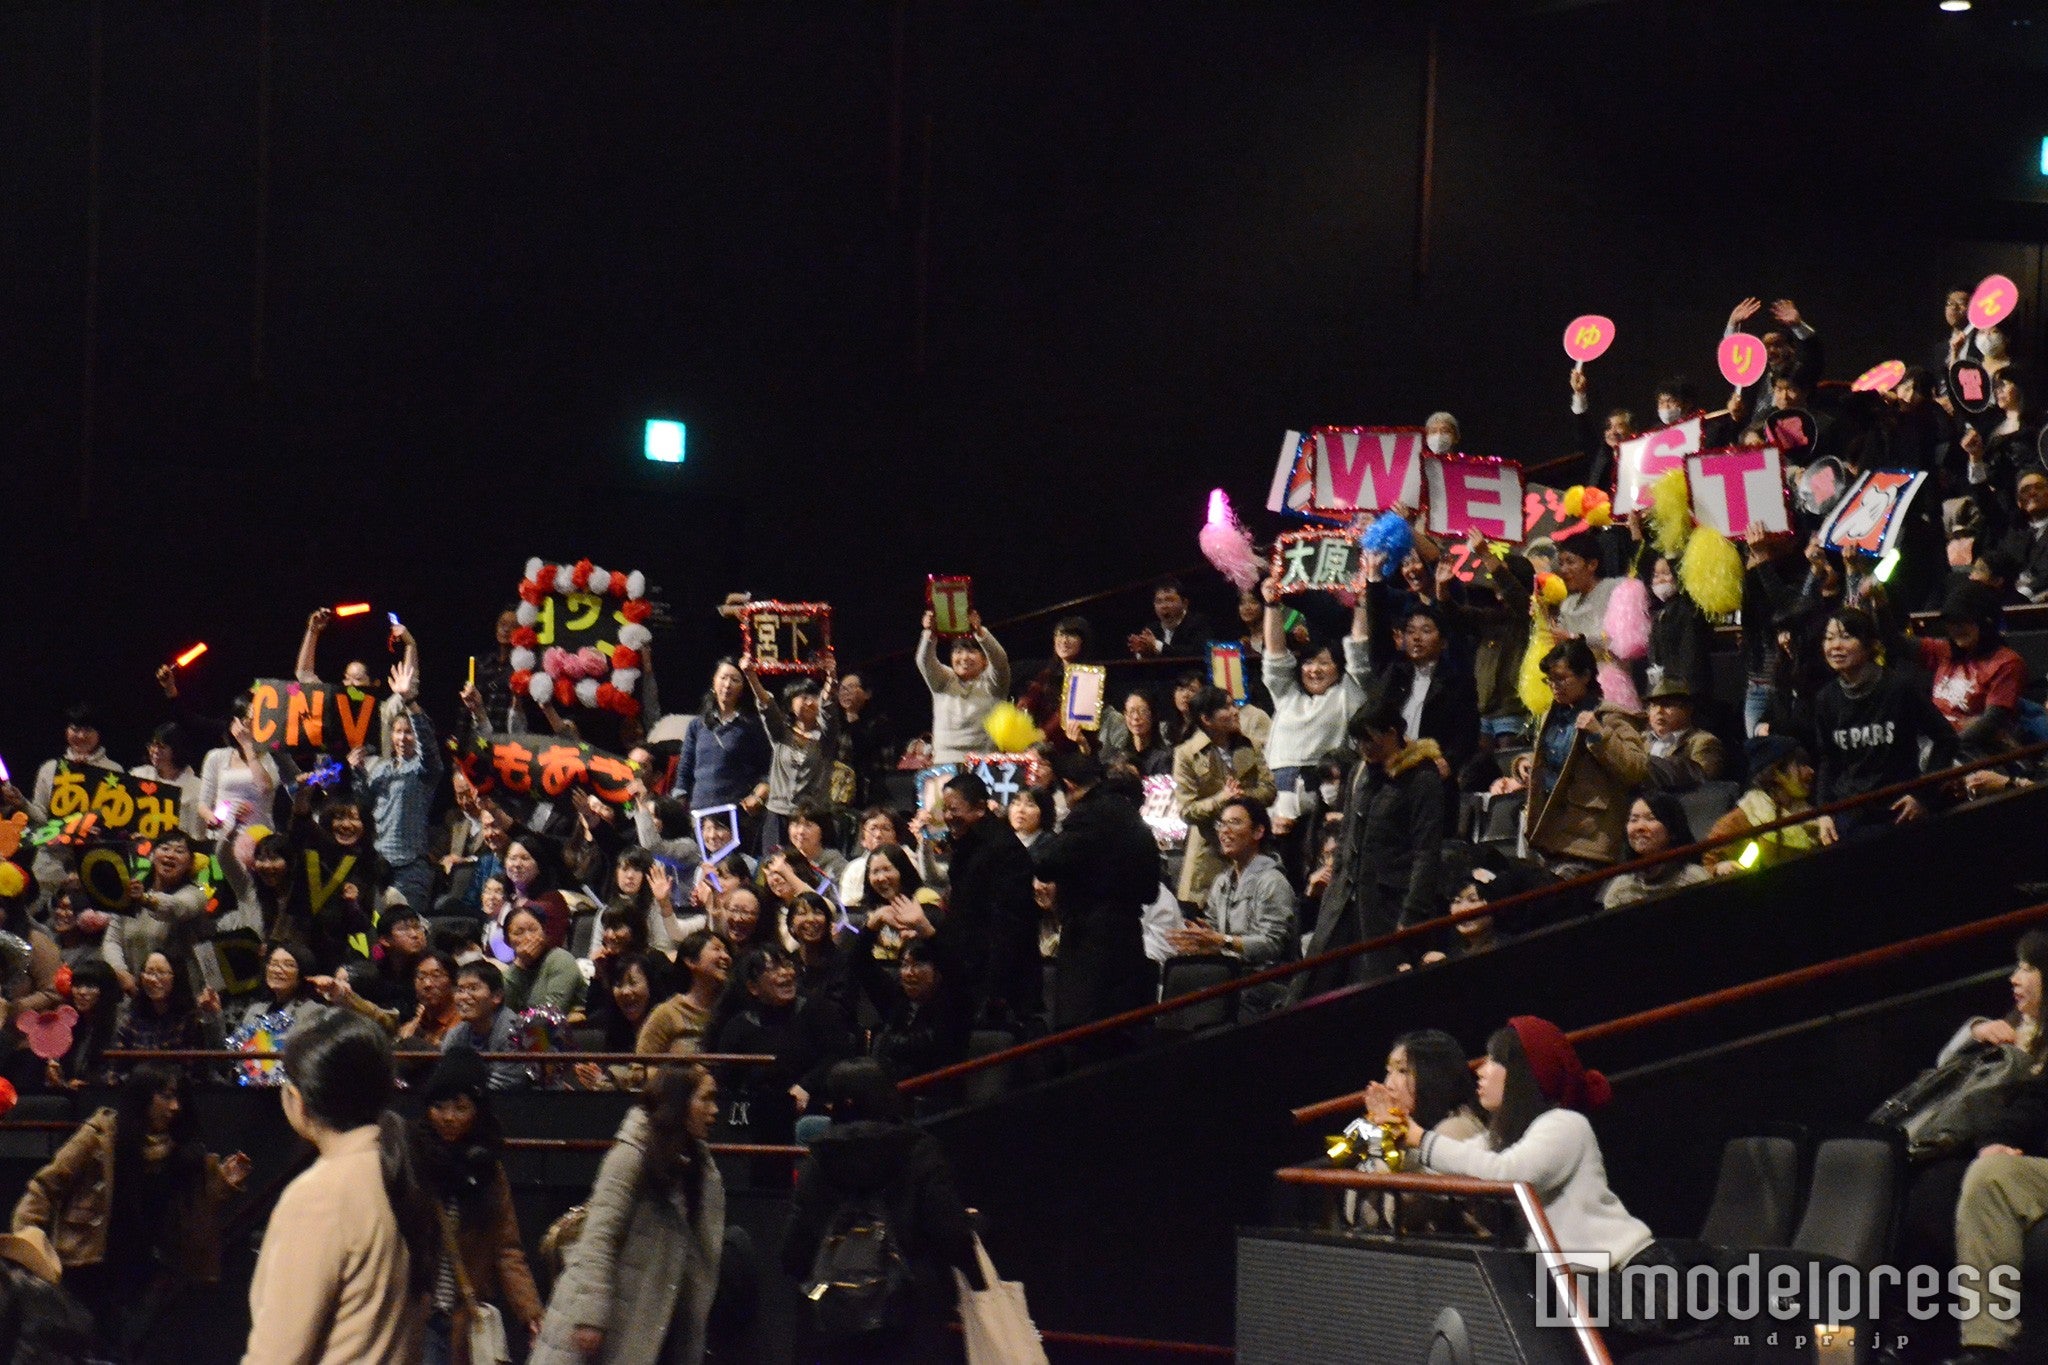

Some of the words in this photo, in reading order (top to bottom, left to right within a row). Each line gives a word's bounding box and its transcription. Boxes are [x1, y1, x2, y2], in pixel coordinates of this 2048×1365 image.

[1575, 324, 1602, 350] ゆ
[1732, 344, 1753, 375] り
[1280, 538, 1351, 587] 大原
[935, 582, 968, 628] T
[754, 613, 812, 662] 宮下
[1212, 648, 1240, 699] T
[1068, 675, 1094, 722] L
[50, 771, 181, 840] あゆみ
